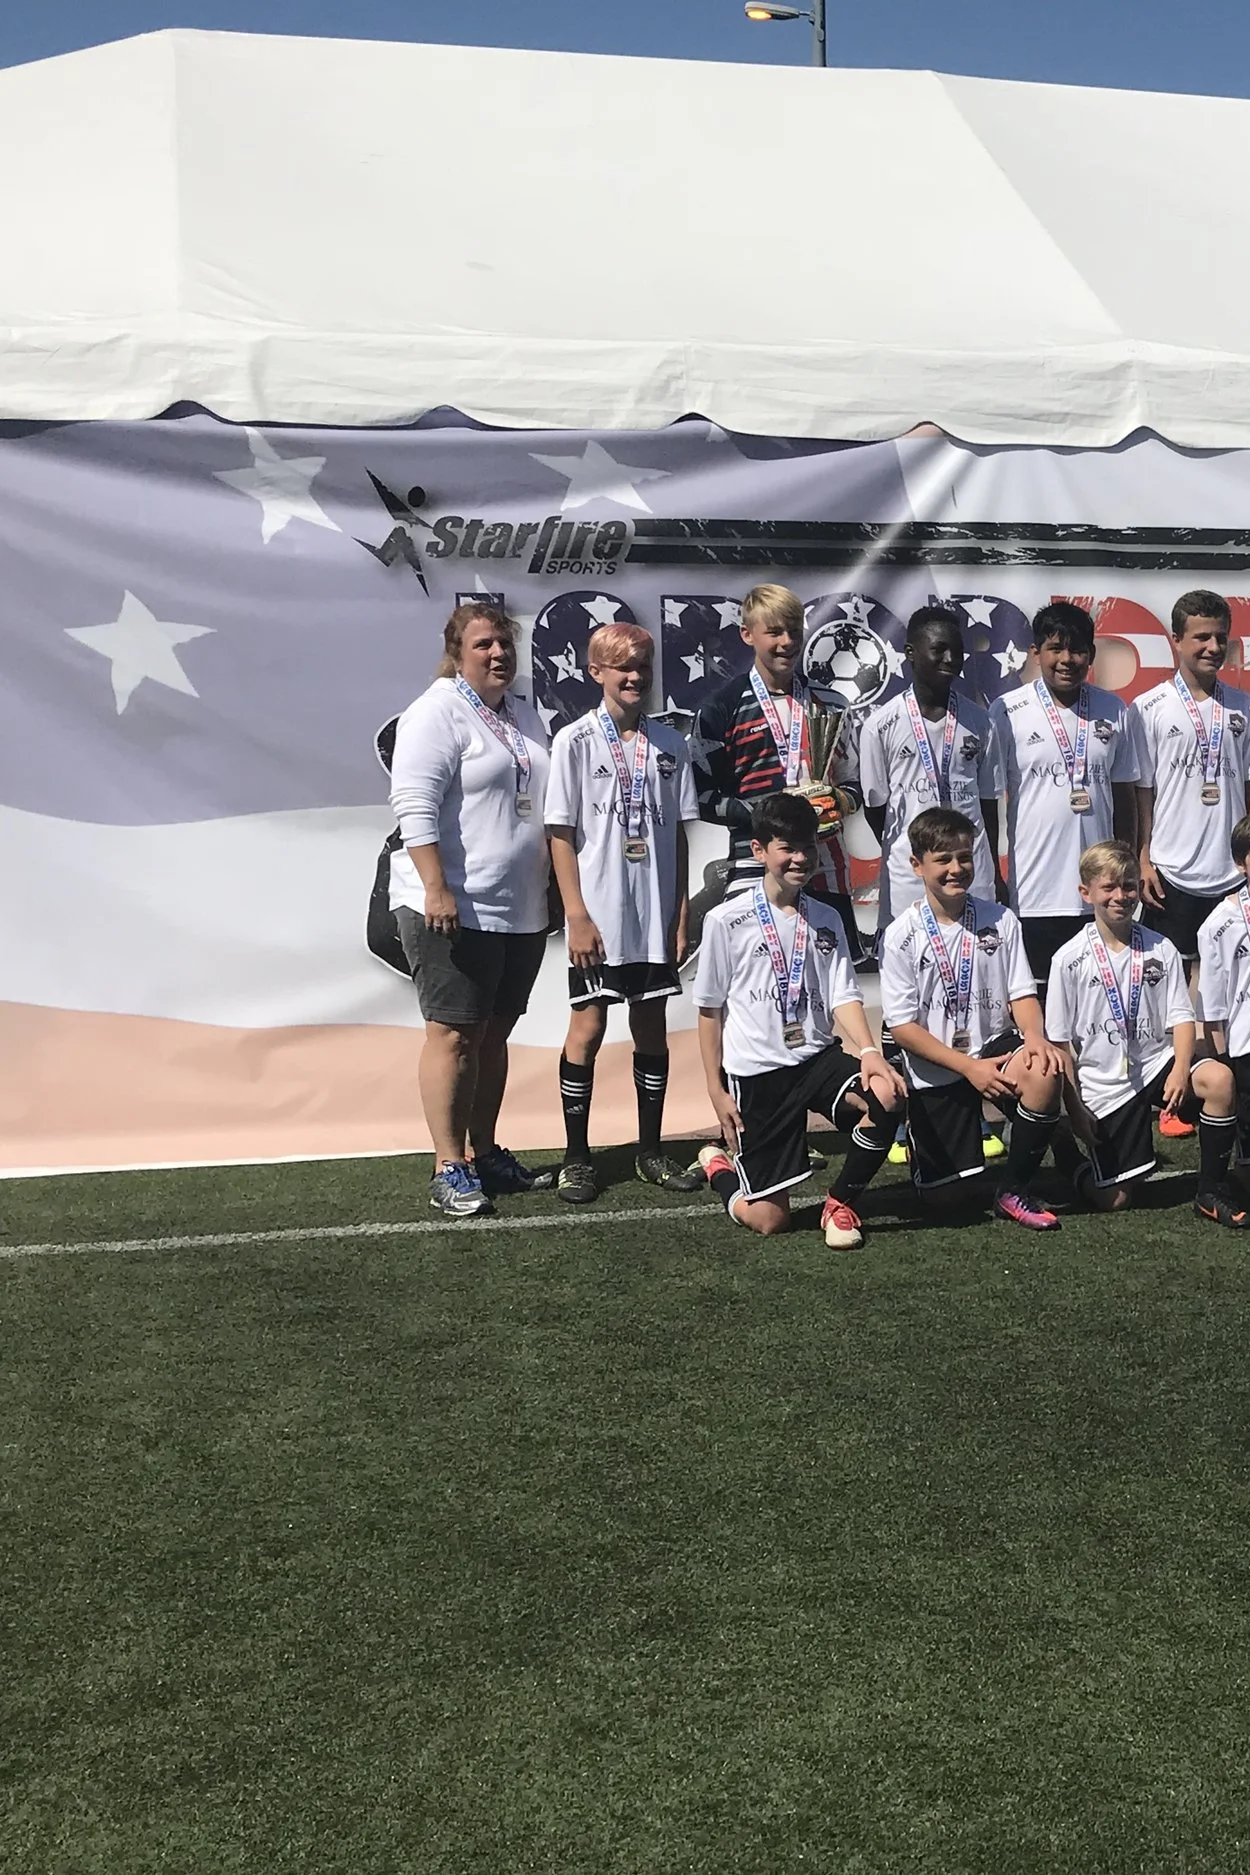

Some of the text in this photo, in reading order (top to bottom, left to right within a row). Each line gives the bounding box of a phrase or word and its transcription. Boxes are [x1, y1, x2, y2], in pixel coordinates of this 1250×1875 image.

[426, 515, 627, 574] Starfire
[546, 561, 617, 575] SPORTS
[1143, 692, 1167, 711] FORCE
